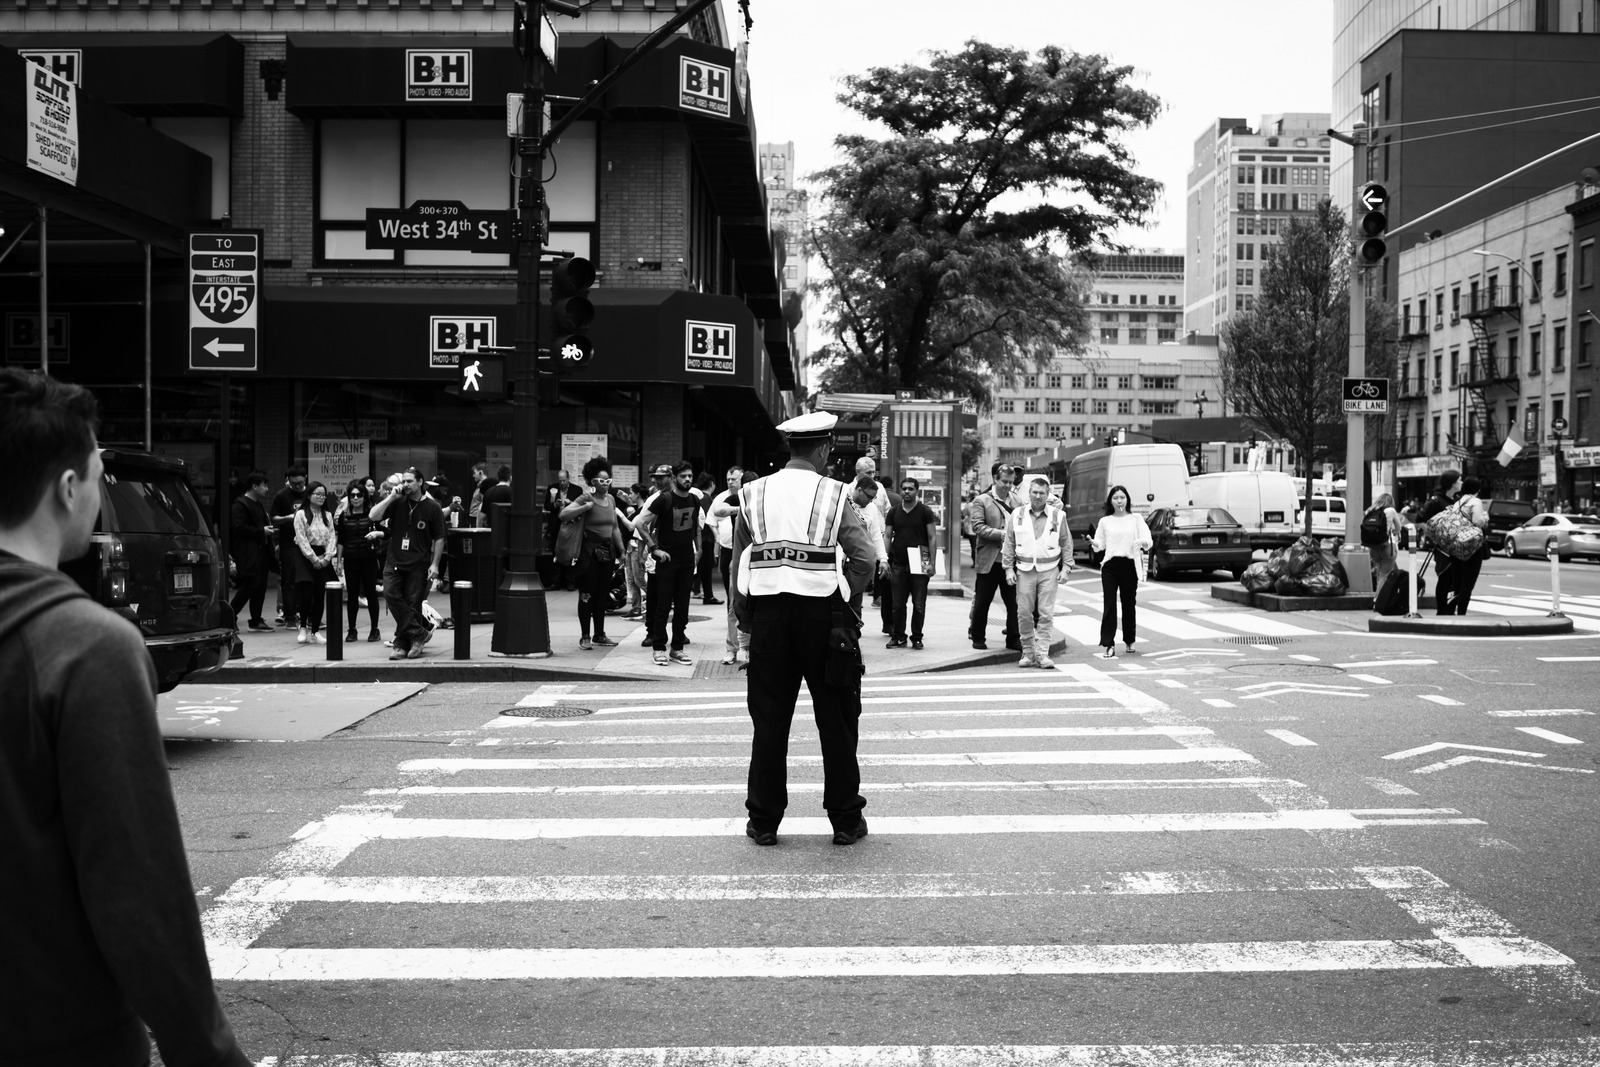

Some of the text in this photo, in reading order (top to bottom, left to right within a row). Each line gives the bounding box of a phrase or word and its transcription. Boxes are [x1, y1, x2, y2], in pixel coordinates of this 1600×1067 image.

[414, 55, 465, 83] B&H
[34, 68, 70, 102] ELITE
[686, 63, 725, 99] B&H
[409, 88, 469, 97] PHOTO VIDEO PRO AUDIO
[36, 91, 71, 115] SCAFFOLD
[50, 109, 70, 125] HOIST
[36, 132, 71, 156] SHED HOIST
[40, 145, 68, 165] SCAFFOLD
[419, 206, 458, 215] 300 370
[378, 218, 498, 240] West 34th St
[215, 238, 232, 248] TO
[212, 257, 235, 268] EAST
[199, 286, 248, 314] 495
[437, 322, 488, 349] B&H
[692, 327, 729, 356] B&H
[432, 354, 460, 364] PHOTO VID
[1345, 401, 1386, 410] BIKE LANE
[881, 416, 889, 459] Newsstand
[313, 442, 365, 454] BUY ONLINE
[325, 454, 354, 464] PICKUP
[321, 464, 357, 474] IN-STORE
[679, 512, 689, 527] F
[763, 547, 809, 562] NYPD
